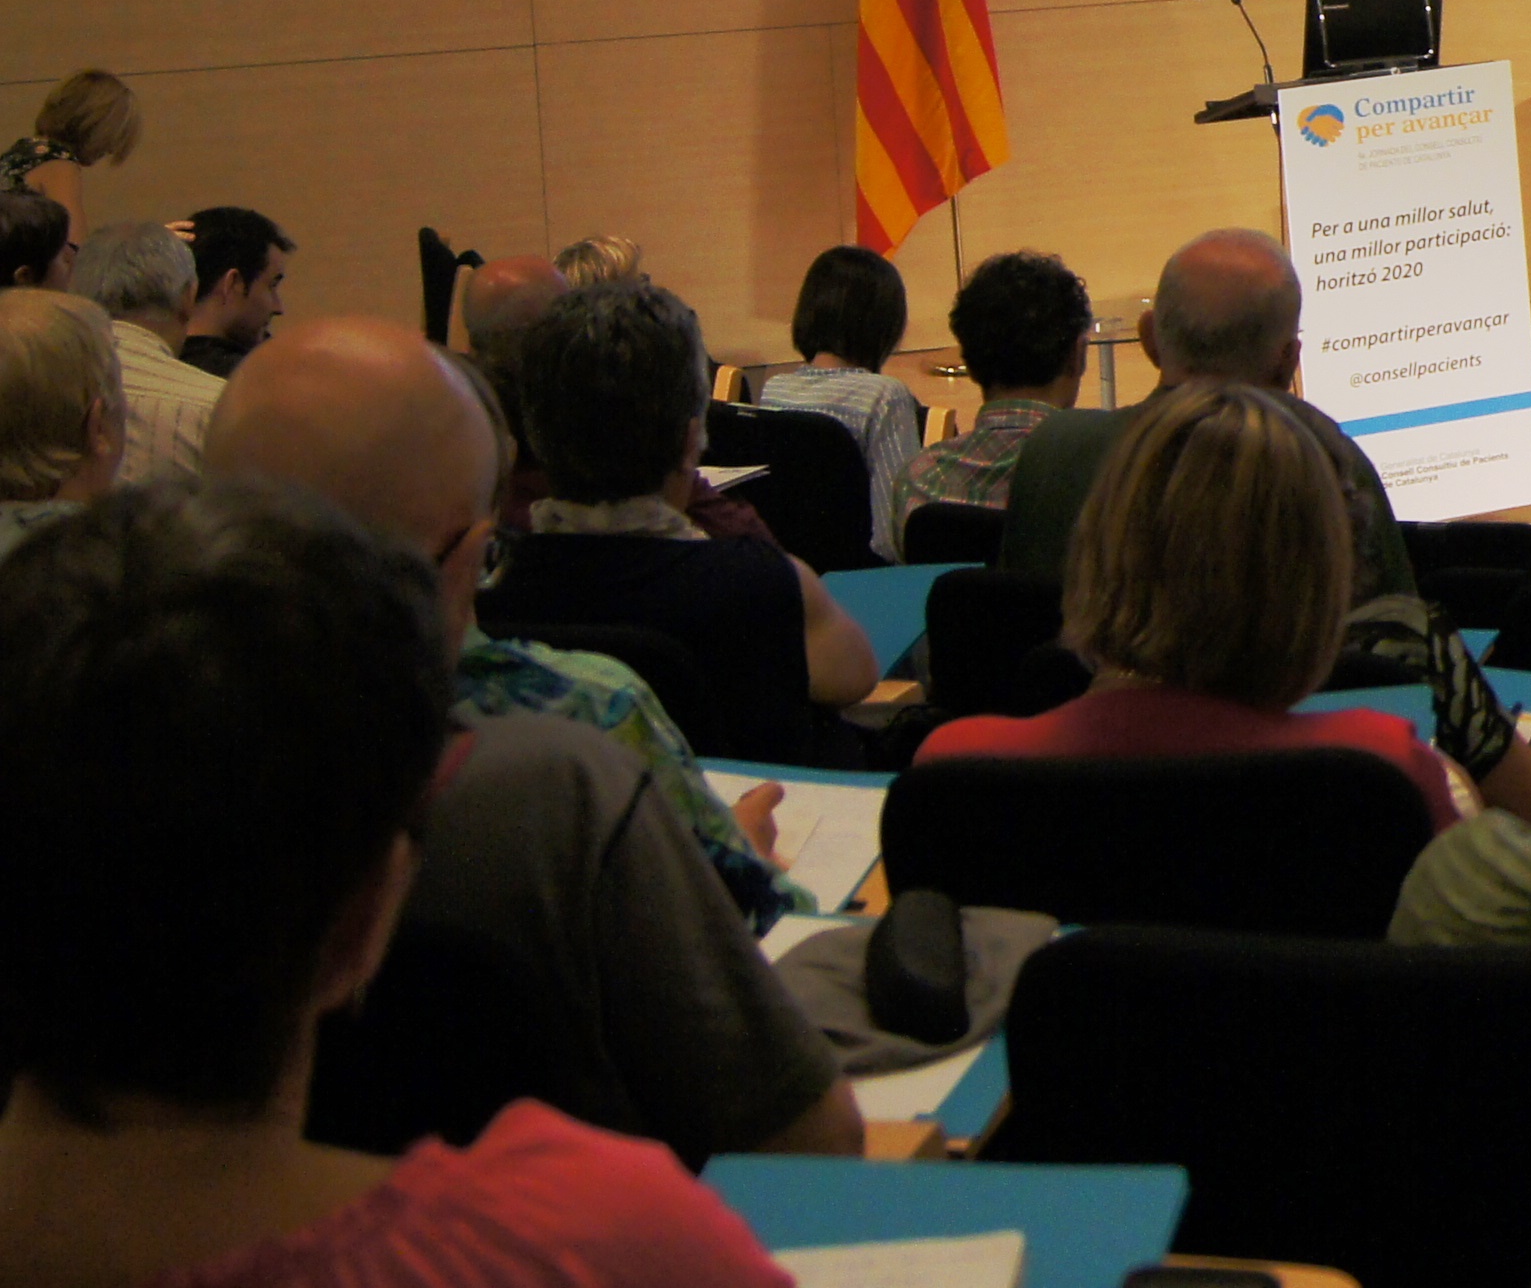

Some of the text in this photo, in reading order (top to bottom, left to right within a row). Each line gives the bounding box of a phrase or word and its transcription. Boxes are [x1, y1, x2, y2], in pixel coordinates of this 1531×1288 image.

[1354, 86, 1475, 118] Compartir
[1356, 108, 1493, 144] per avançar
[1311, 199, 1494, 238] Per a una millor salut,
[1314, 224, 1511, 265] una millor participació:
[1316, 261, 1423, 291] horitzó 2020
[1321, 313, 1509, 352] #compartirperavançar
[1350, 354, 1482, 388] @consellpacients
[1382, 453, 1508, 479] Consell Consultiu Pacients
